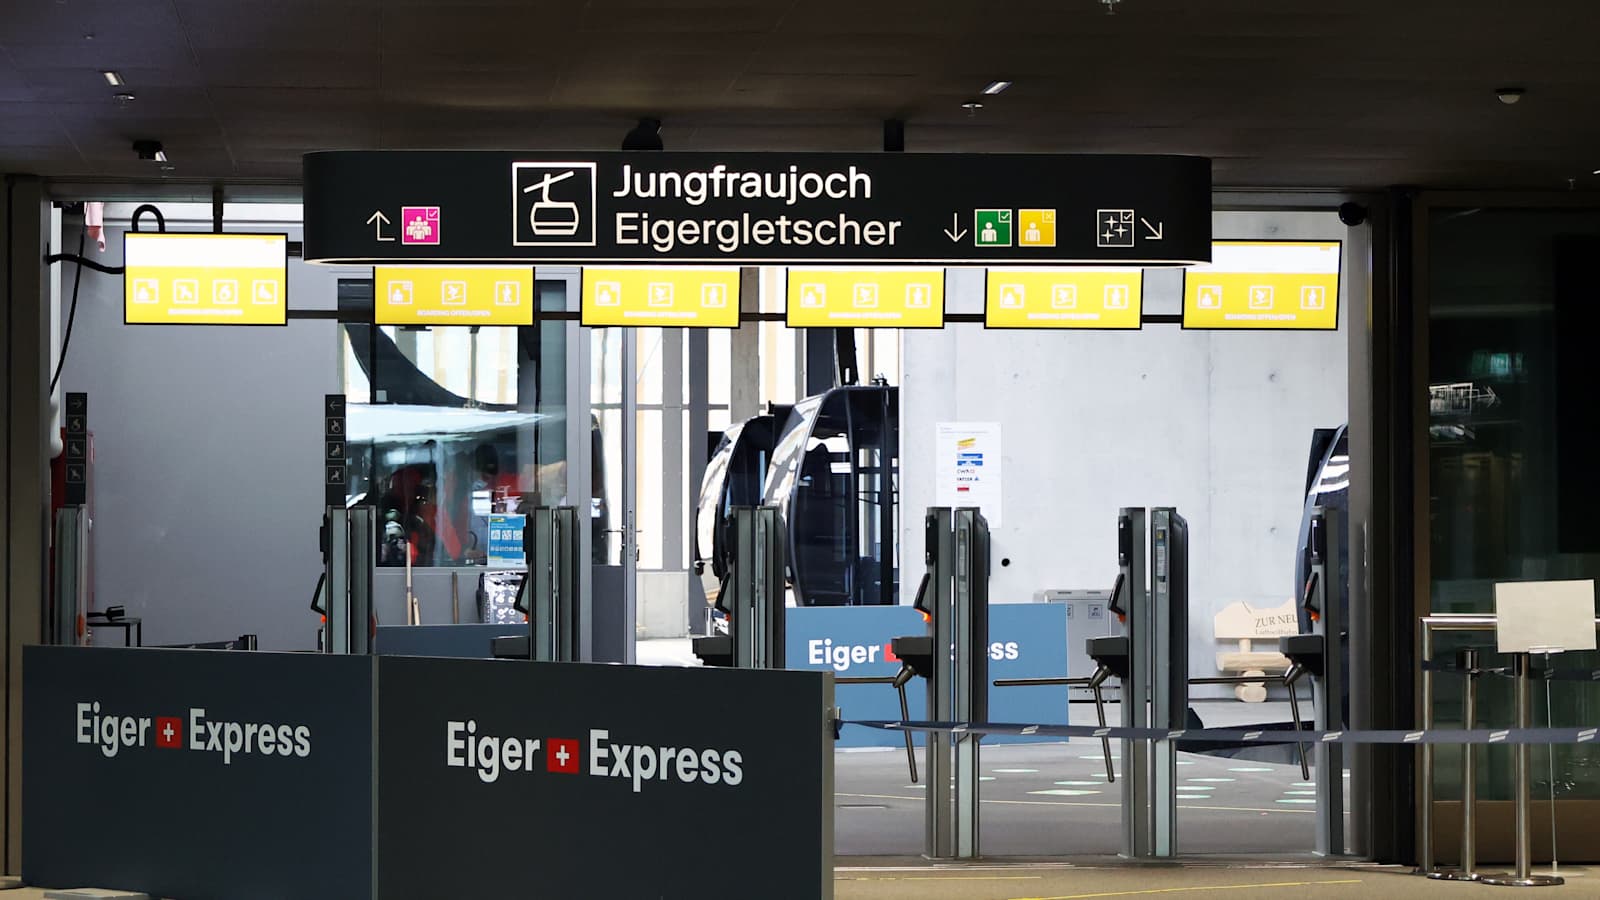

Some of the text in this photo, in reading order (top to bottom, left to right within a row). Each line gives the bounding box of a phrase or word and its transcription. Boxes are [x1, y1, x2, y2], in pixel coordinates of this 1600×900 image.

[613, 164, 871, 205] Jungfraujoch
[616, 212, 902, 252] Eigergletscher
[1256, 616, 1276, 628] ZUR
[808, 638, 880, 671] Eiger
[77, 701, 311, 764] Eiger Express
[447, 719, 743, 793] Eiger Express
